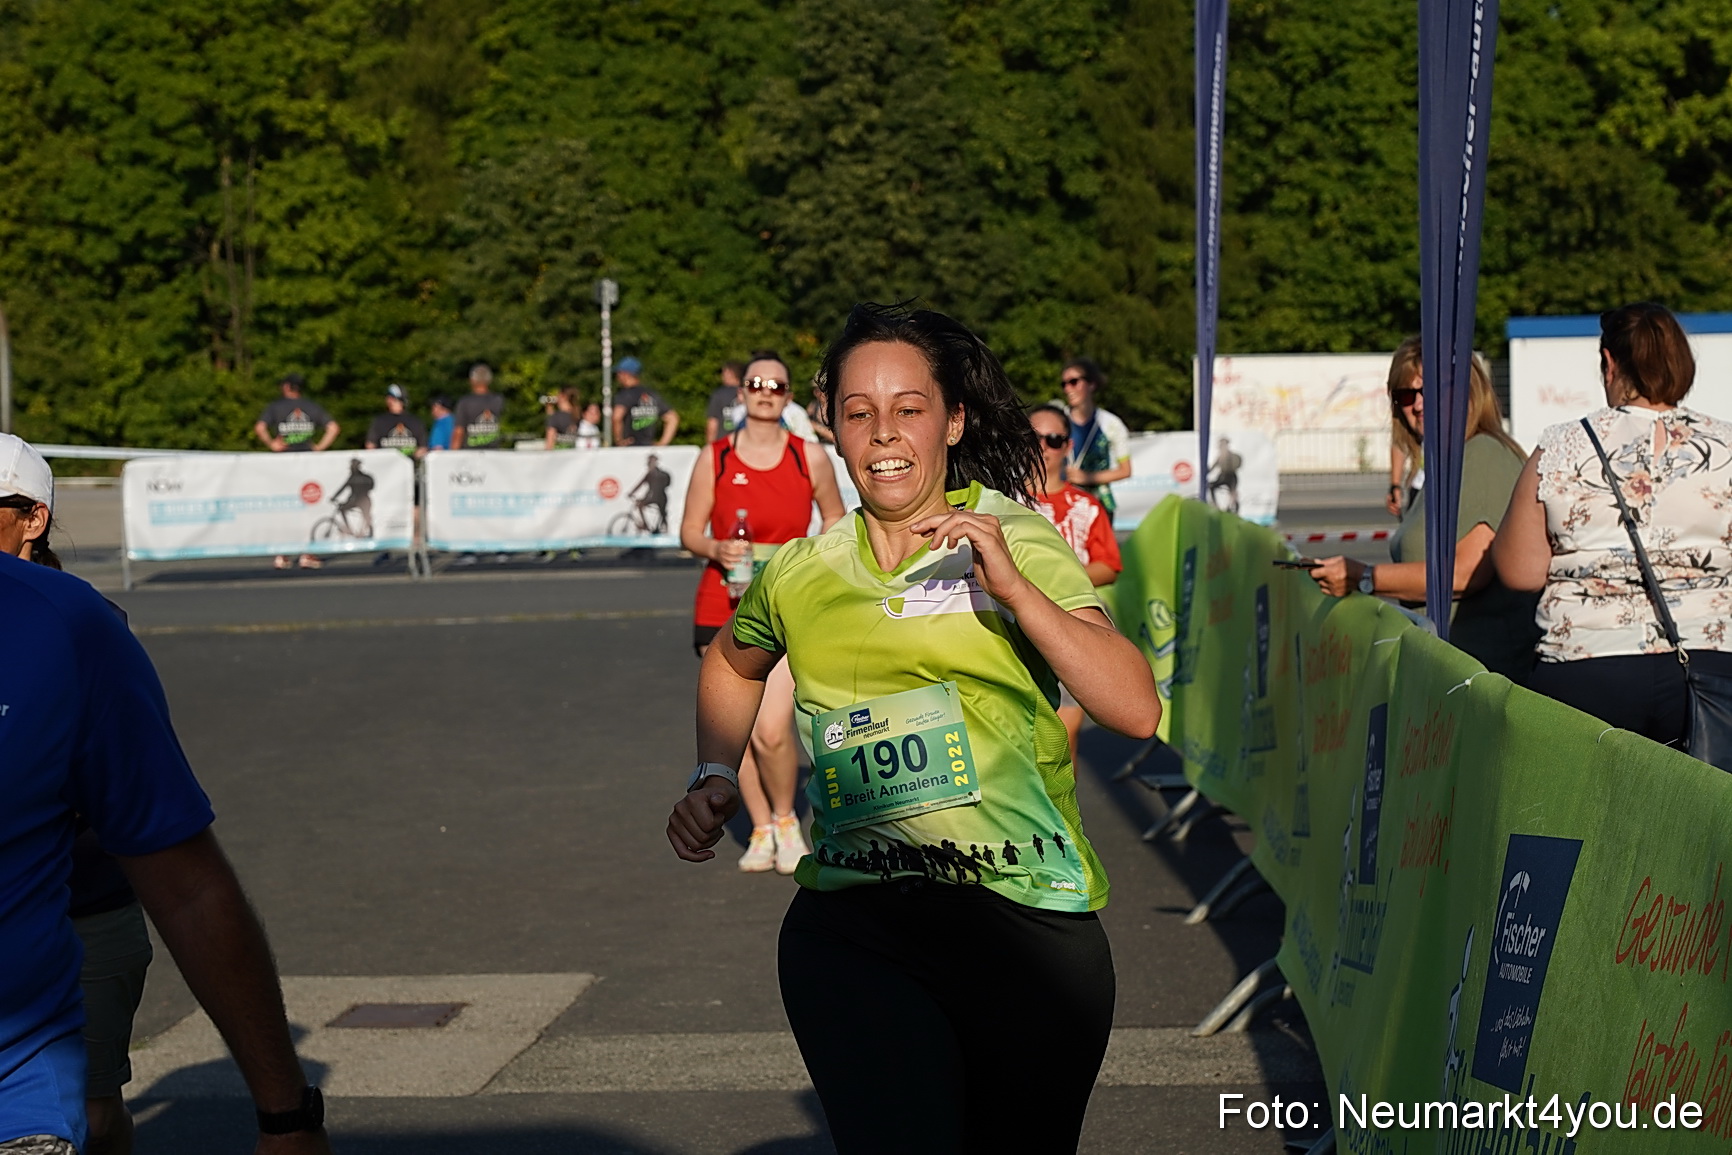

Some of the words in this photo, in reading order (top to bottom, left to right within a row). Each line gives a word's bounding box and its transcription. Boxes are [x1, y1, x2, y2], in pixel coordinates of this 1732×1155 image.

[846, 718, 889, 739] Firmenlauf
[863, 727, 890, 739] neumarkt
[851, 733, 928, 785] 190
[944, 730, 969, 787] 2022
[825, 766, 842, 809] RUN
[844, 788, 876, 807] Breit
[879, 774, 949, 799] Annalena
[1500, 911, 1547, 958] Fischer
[1616, 861, 1725, 977] Gesunde
[1498, 962, 1534, 985] AUTOMOBILE
